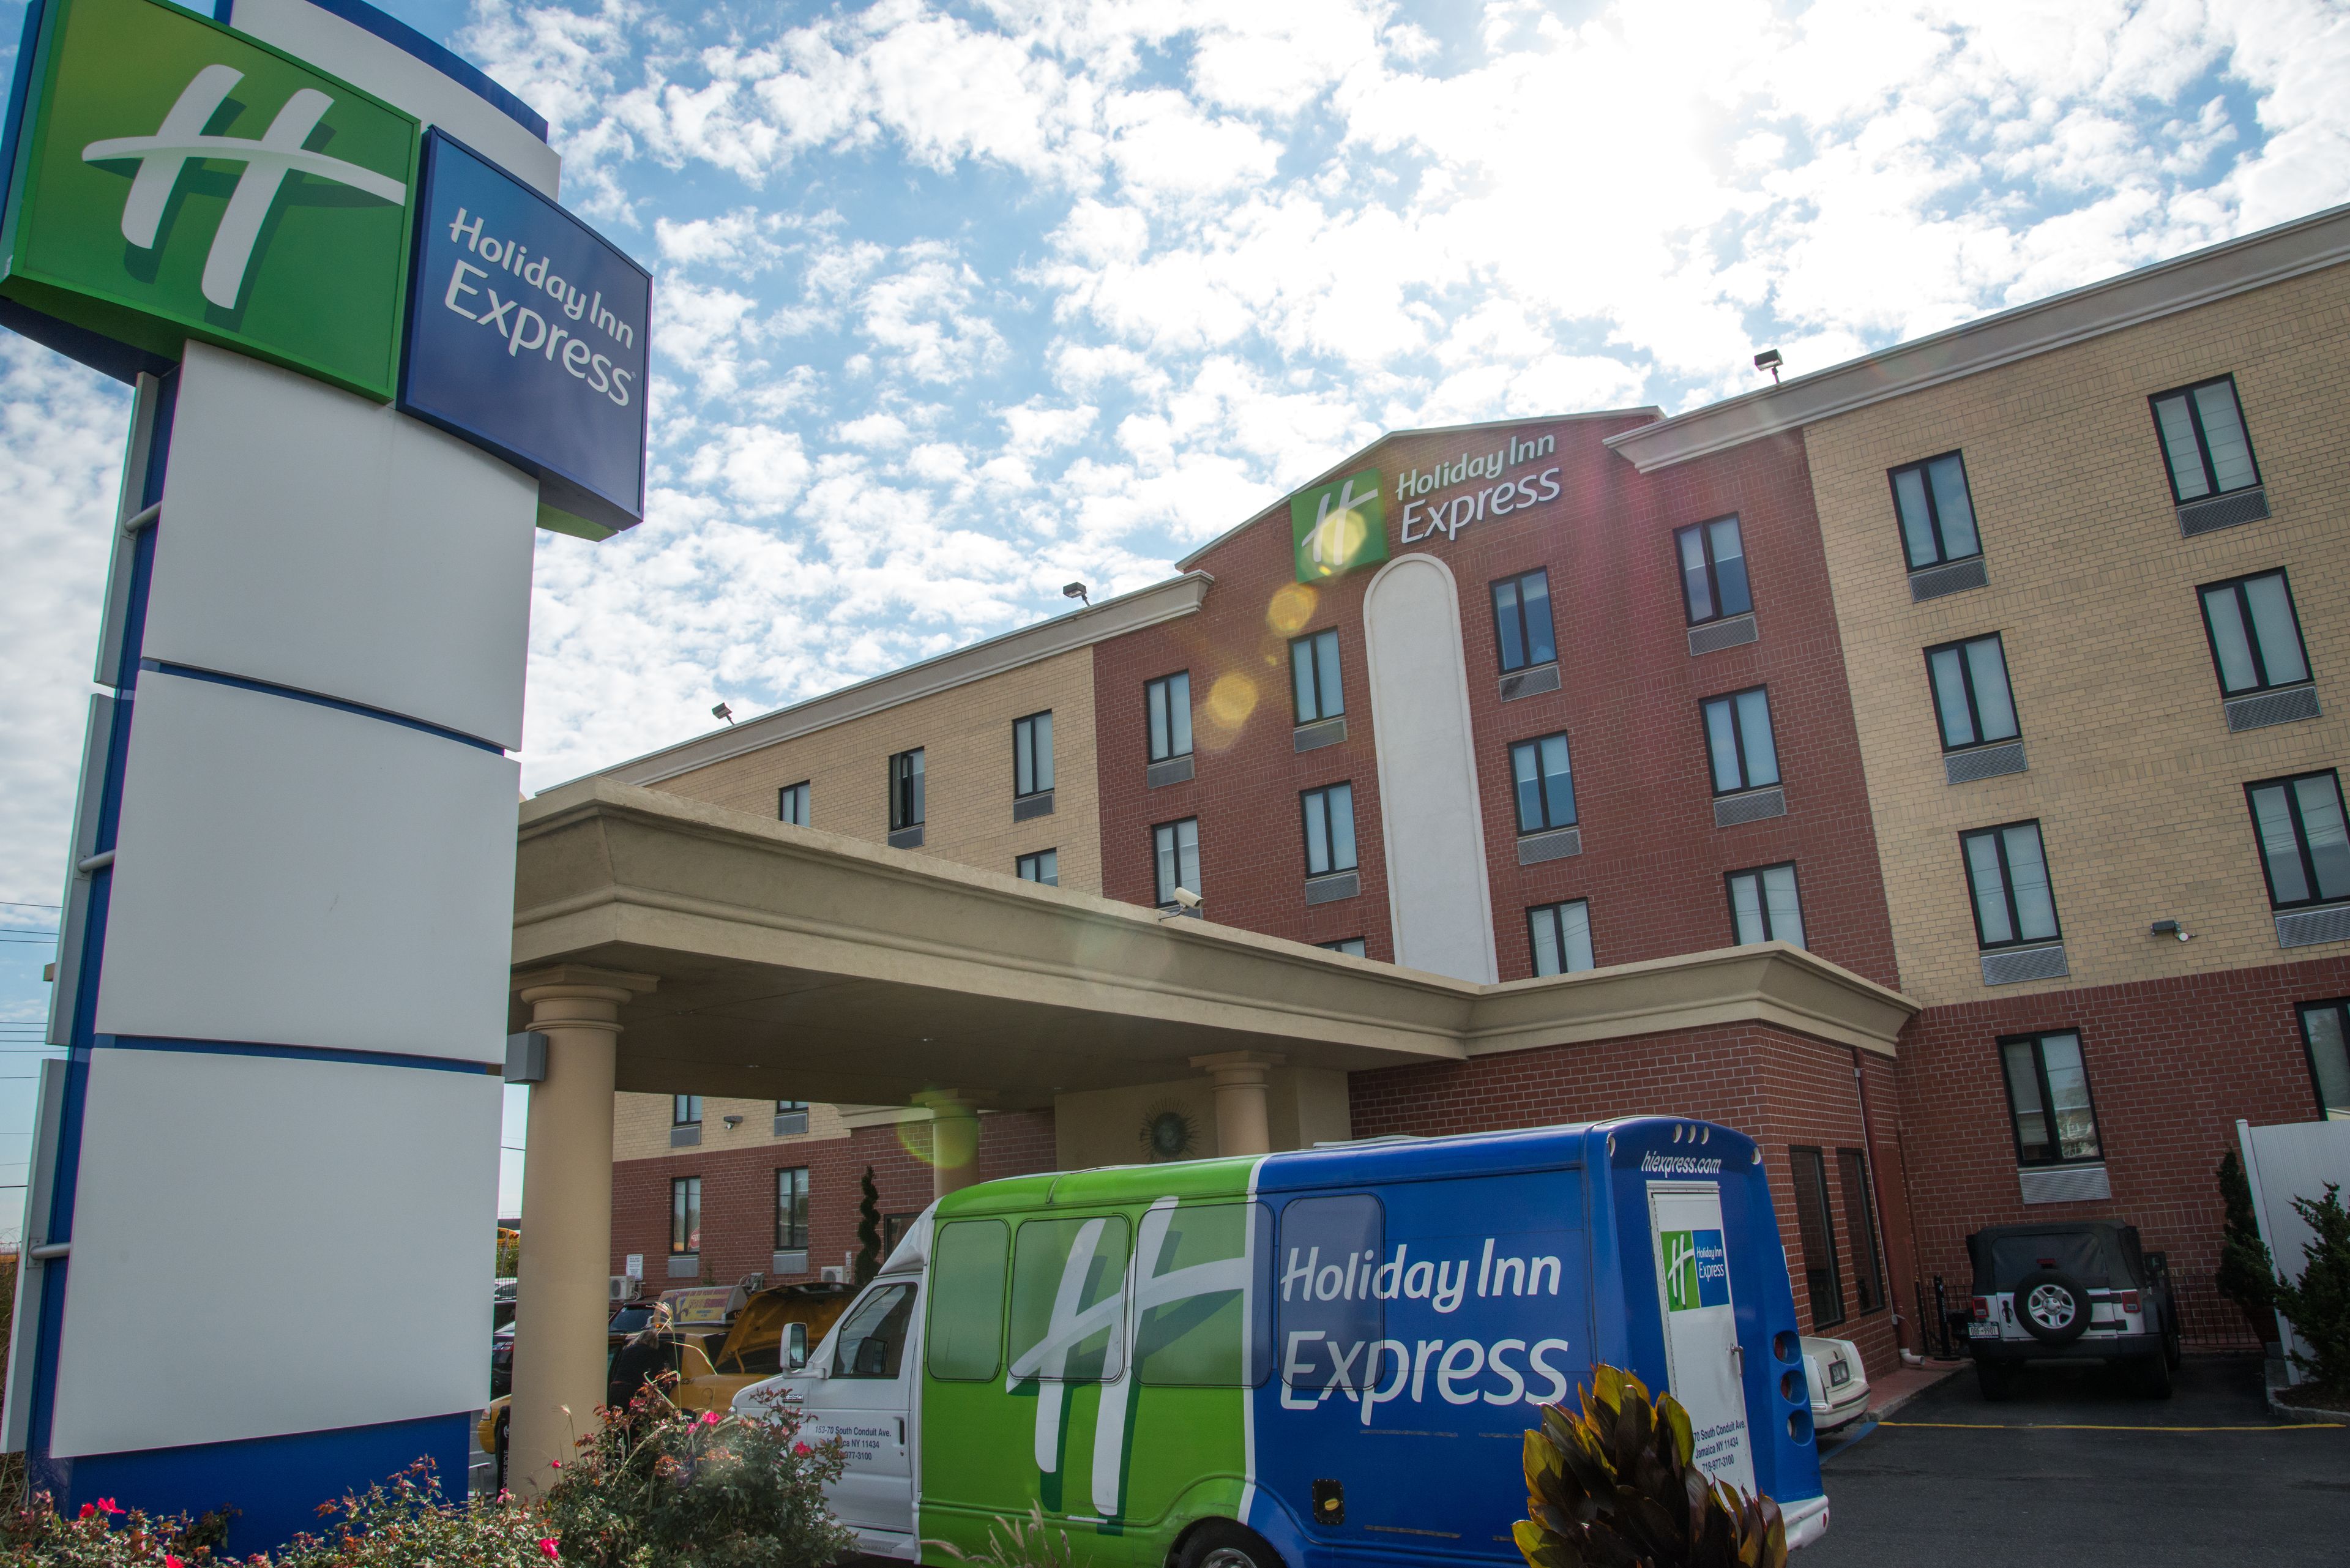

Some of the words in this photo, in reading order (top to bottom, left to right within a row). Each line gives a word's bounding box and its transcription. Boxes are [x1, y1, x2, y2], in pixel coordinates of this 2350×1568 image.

[449, 207, 586, 321] Holiday
[590, 291, 633, 349] Inn
[445, 259, 631, 406] Express
[1395, 450, 1503, 500] Holiday
[1510, 435, 1554, 465] Inn
[1401, 468, 1560, 543] Express
[1641, 1151, 1721, 1178] hiexpress.com
[1696, 1246, 1715, 1260] Holiday
[1280, 1244, 1469, 1313] Holiday
[1477, 1238, 1561, 1296] Inn
[1699, 1261, 1724, 1282] Express
[1280, 1331, 1569, 1425] Express
[815, 1425, 834, 1434] 153-70
[835, 1426, 852, 1435] South
[854, 1427, 877, 1436] Conduit
[878, 1428, 892, 1437] Ave.
[1701, 1427, 1715, 1440] South
[1716, 1421, 1735, 1435] Conduit
[1736, 1419, 1745, 1429] Ave.
[862, 1439, 879, 1449] 11434
[1695, 1445, 1716, 1459] Jamaica
[1716, 1441, 1723, 1452] NY
[1724, 1436, 1739, 1449] 11434
[1702, 1454, 1734, 1473] 718-977-3100
